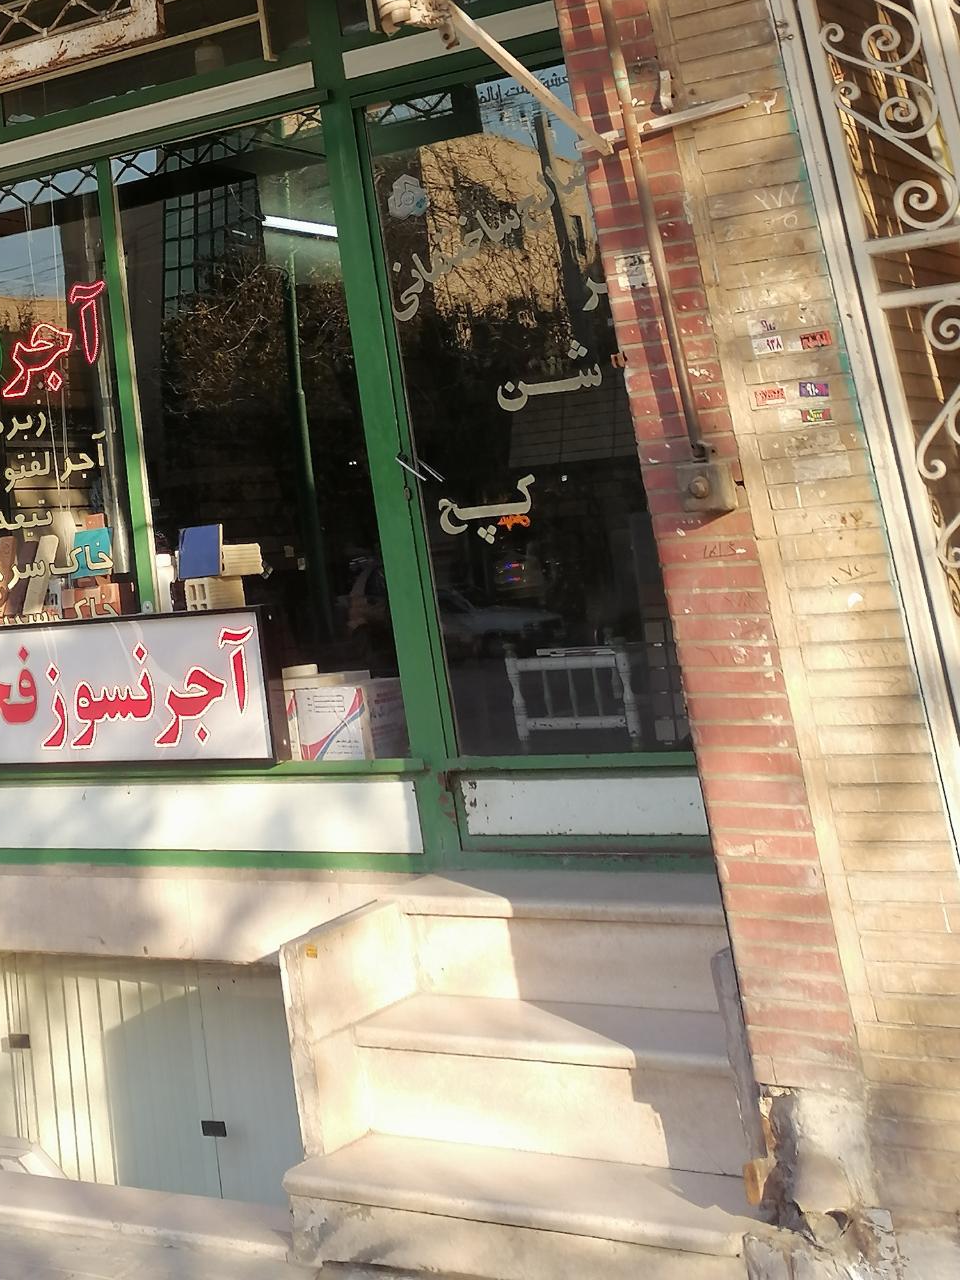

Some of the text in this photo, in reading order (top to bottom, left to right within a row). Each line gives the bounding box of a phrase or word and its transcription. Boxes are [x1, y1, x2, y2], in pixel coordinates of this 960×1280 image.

[393, 209, 521, 323] ساختمانی
[2, 280, 106, 399] آجر
[497, 339, 602, 413] شن
[60, 431, 106, 482] آجر
[49, 541, 114, 576] خاک
[41, 641, 156, 750] نسوز
[155, 623, 255, 748] آجر
